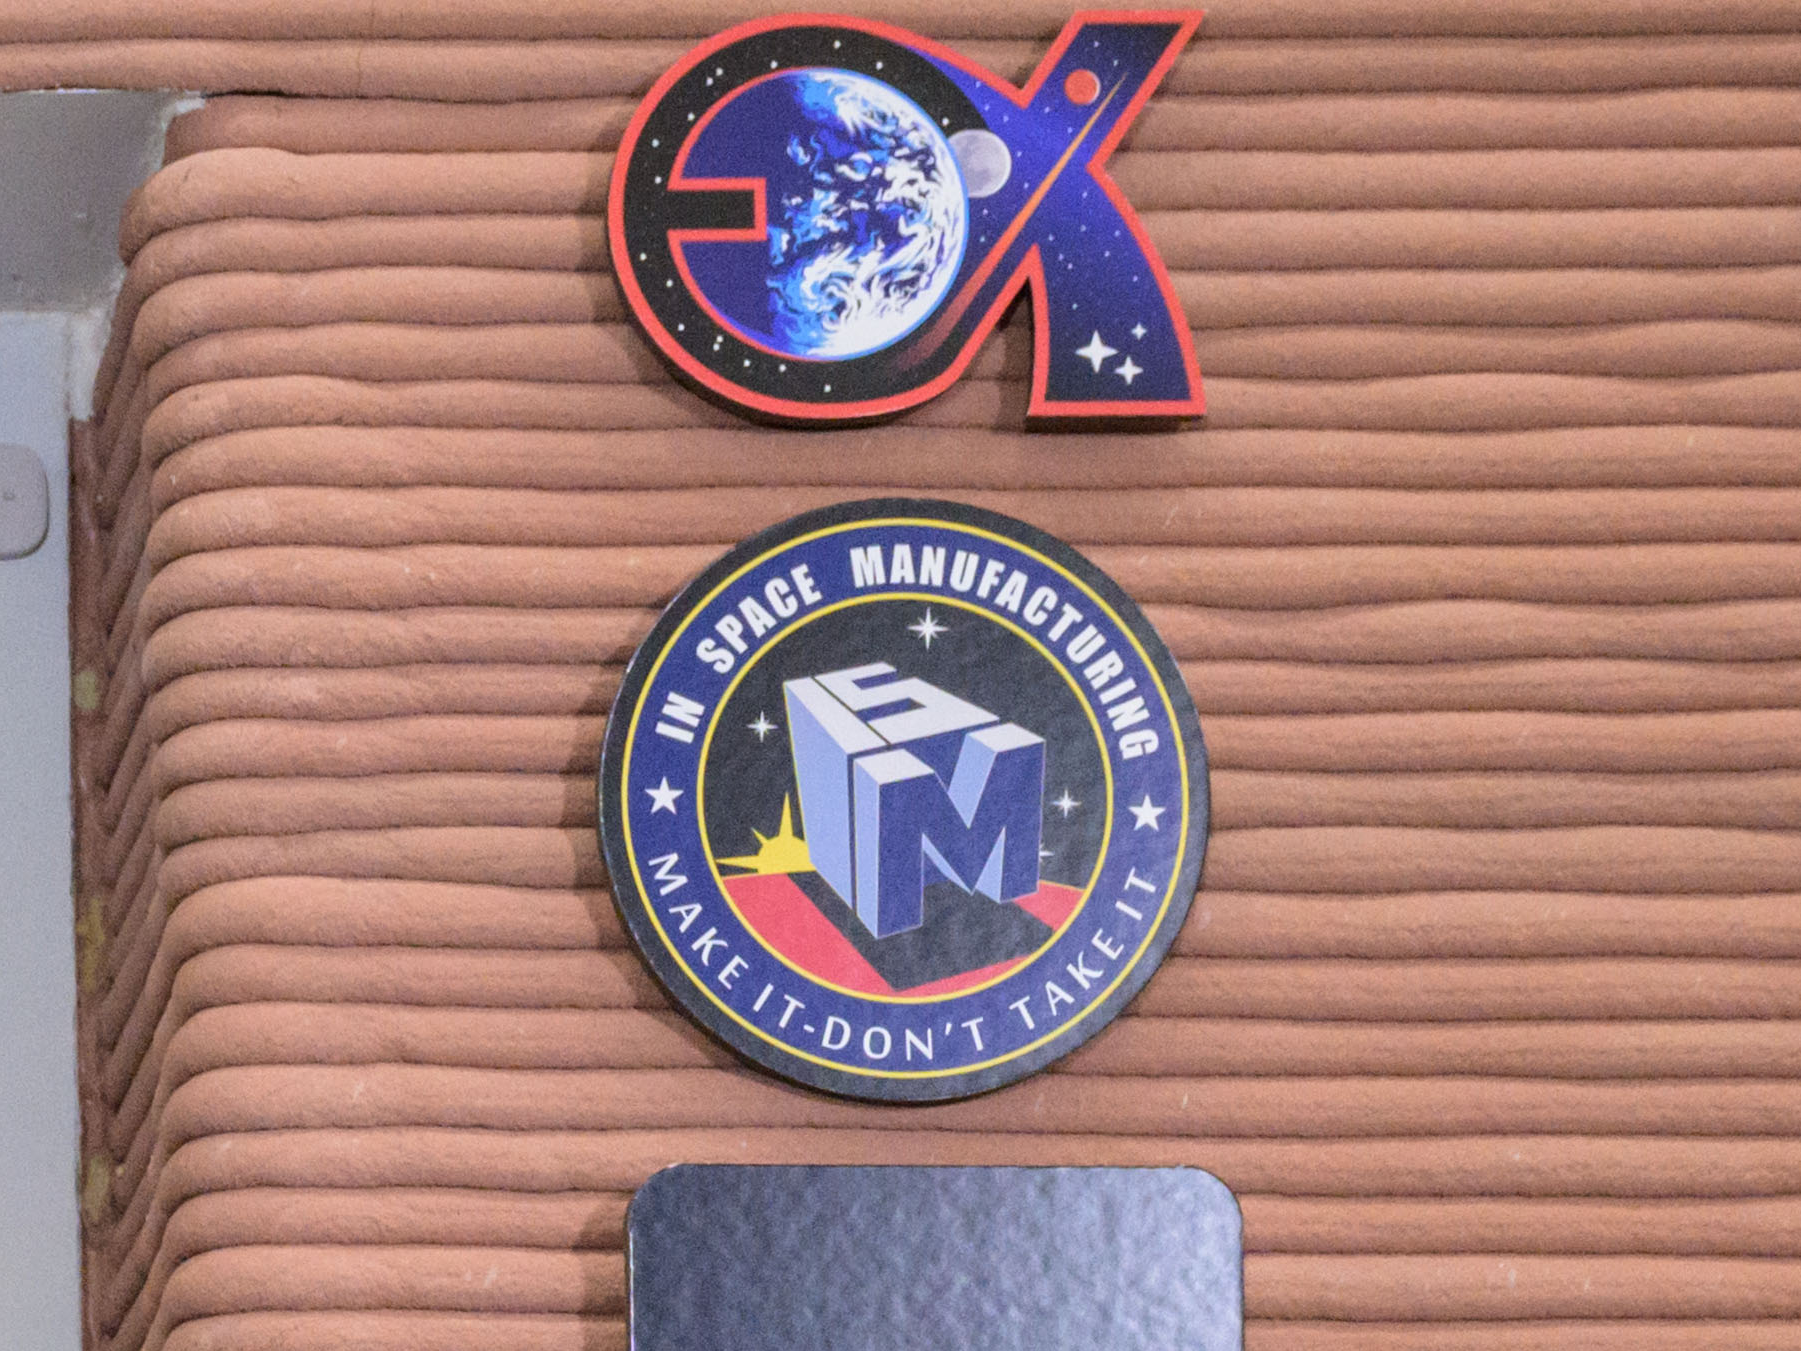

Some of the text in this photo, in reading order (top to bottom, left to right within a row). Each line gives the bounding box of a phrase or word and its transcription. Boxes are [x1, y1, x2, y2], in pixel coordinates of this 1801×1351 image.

[656, 544, 1159, 760] IN SPACE MANUFACTURING
[648, 852, 749, 988] MAKE
[1009, 937, 1124, 1031] TAKE
[1116, 868, 1157, 921] IT
